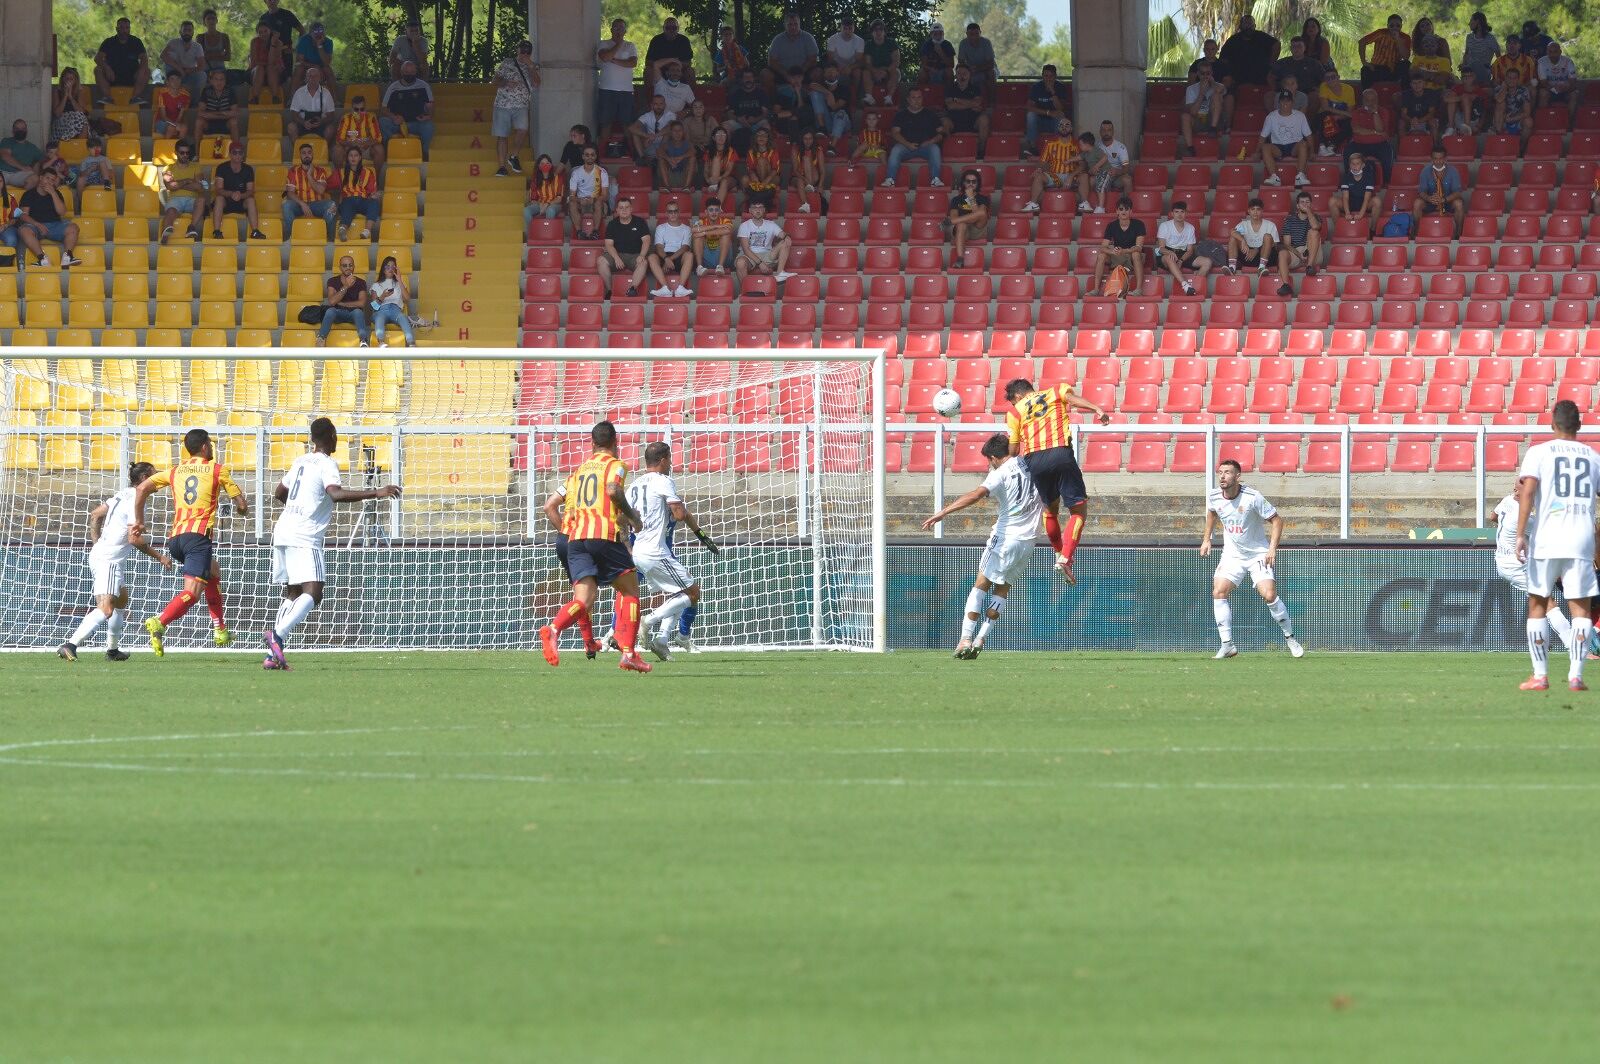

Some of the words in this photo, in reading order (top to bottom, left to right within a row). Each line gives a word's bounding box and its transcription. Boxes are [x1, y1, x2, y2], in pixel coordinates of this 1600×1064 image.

[470, 136, 482, 149] A
[469, 163, 481, 177] B
[467, 190, 479, 203] C
[465, 217, 477, 231] D
[464, 244, 476, 258] E
[462, 272, 473, 286] F
[461, 300, 473, 313] G
[458, 327, 470, 341] H
[452, 437, 464, 449] N
[290, 465, 304, 500] 6
[1554, 456, 1591, 499] 62
[183, 475, 199, 506] 8
[577, 473, 598, 507] 10
